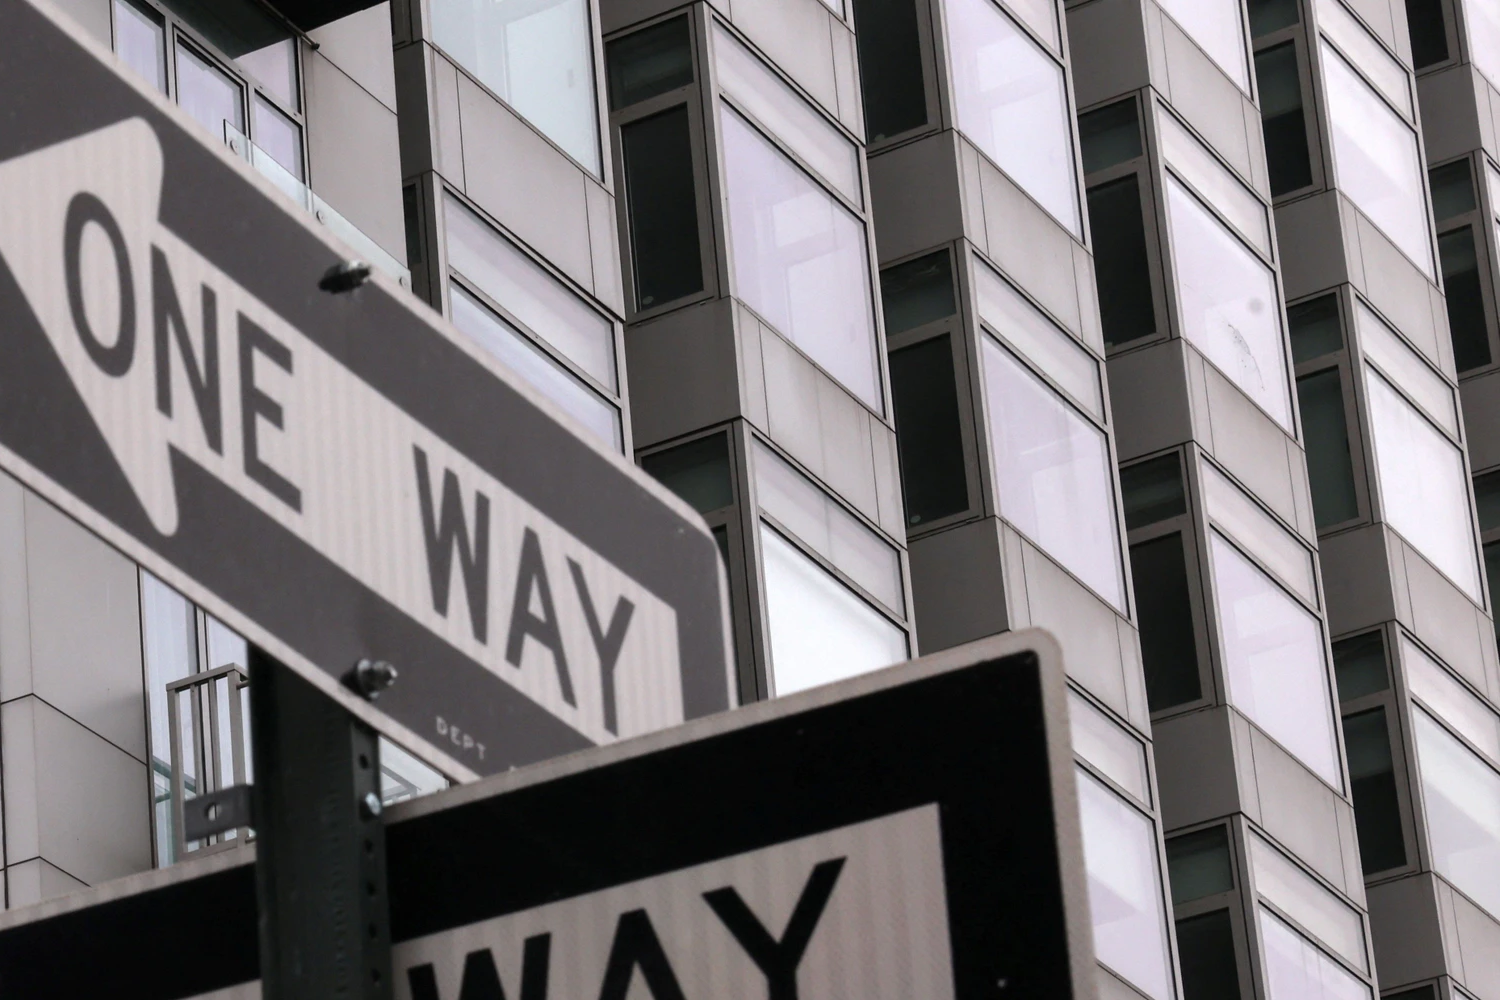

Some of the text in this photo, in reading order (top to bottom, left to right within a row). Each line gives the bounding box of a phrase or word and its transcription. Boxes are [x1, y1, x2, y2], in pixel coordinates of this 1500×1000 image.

[63, 191, 635, 737] ONE WAY
[436, 715, 486, 760] DEPT
